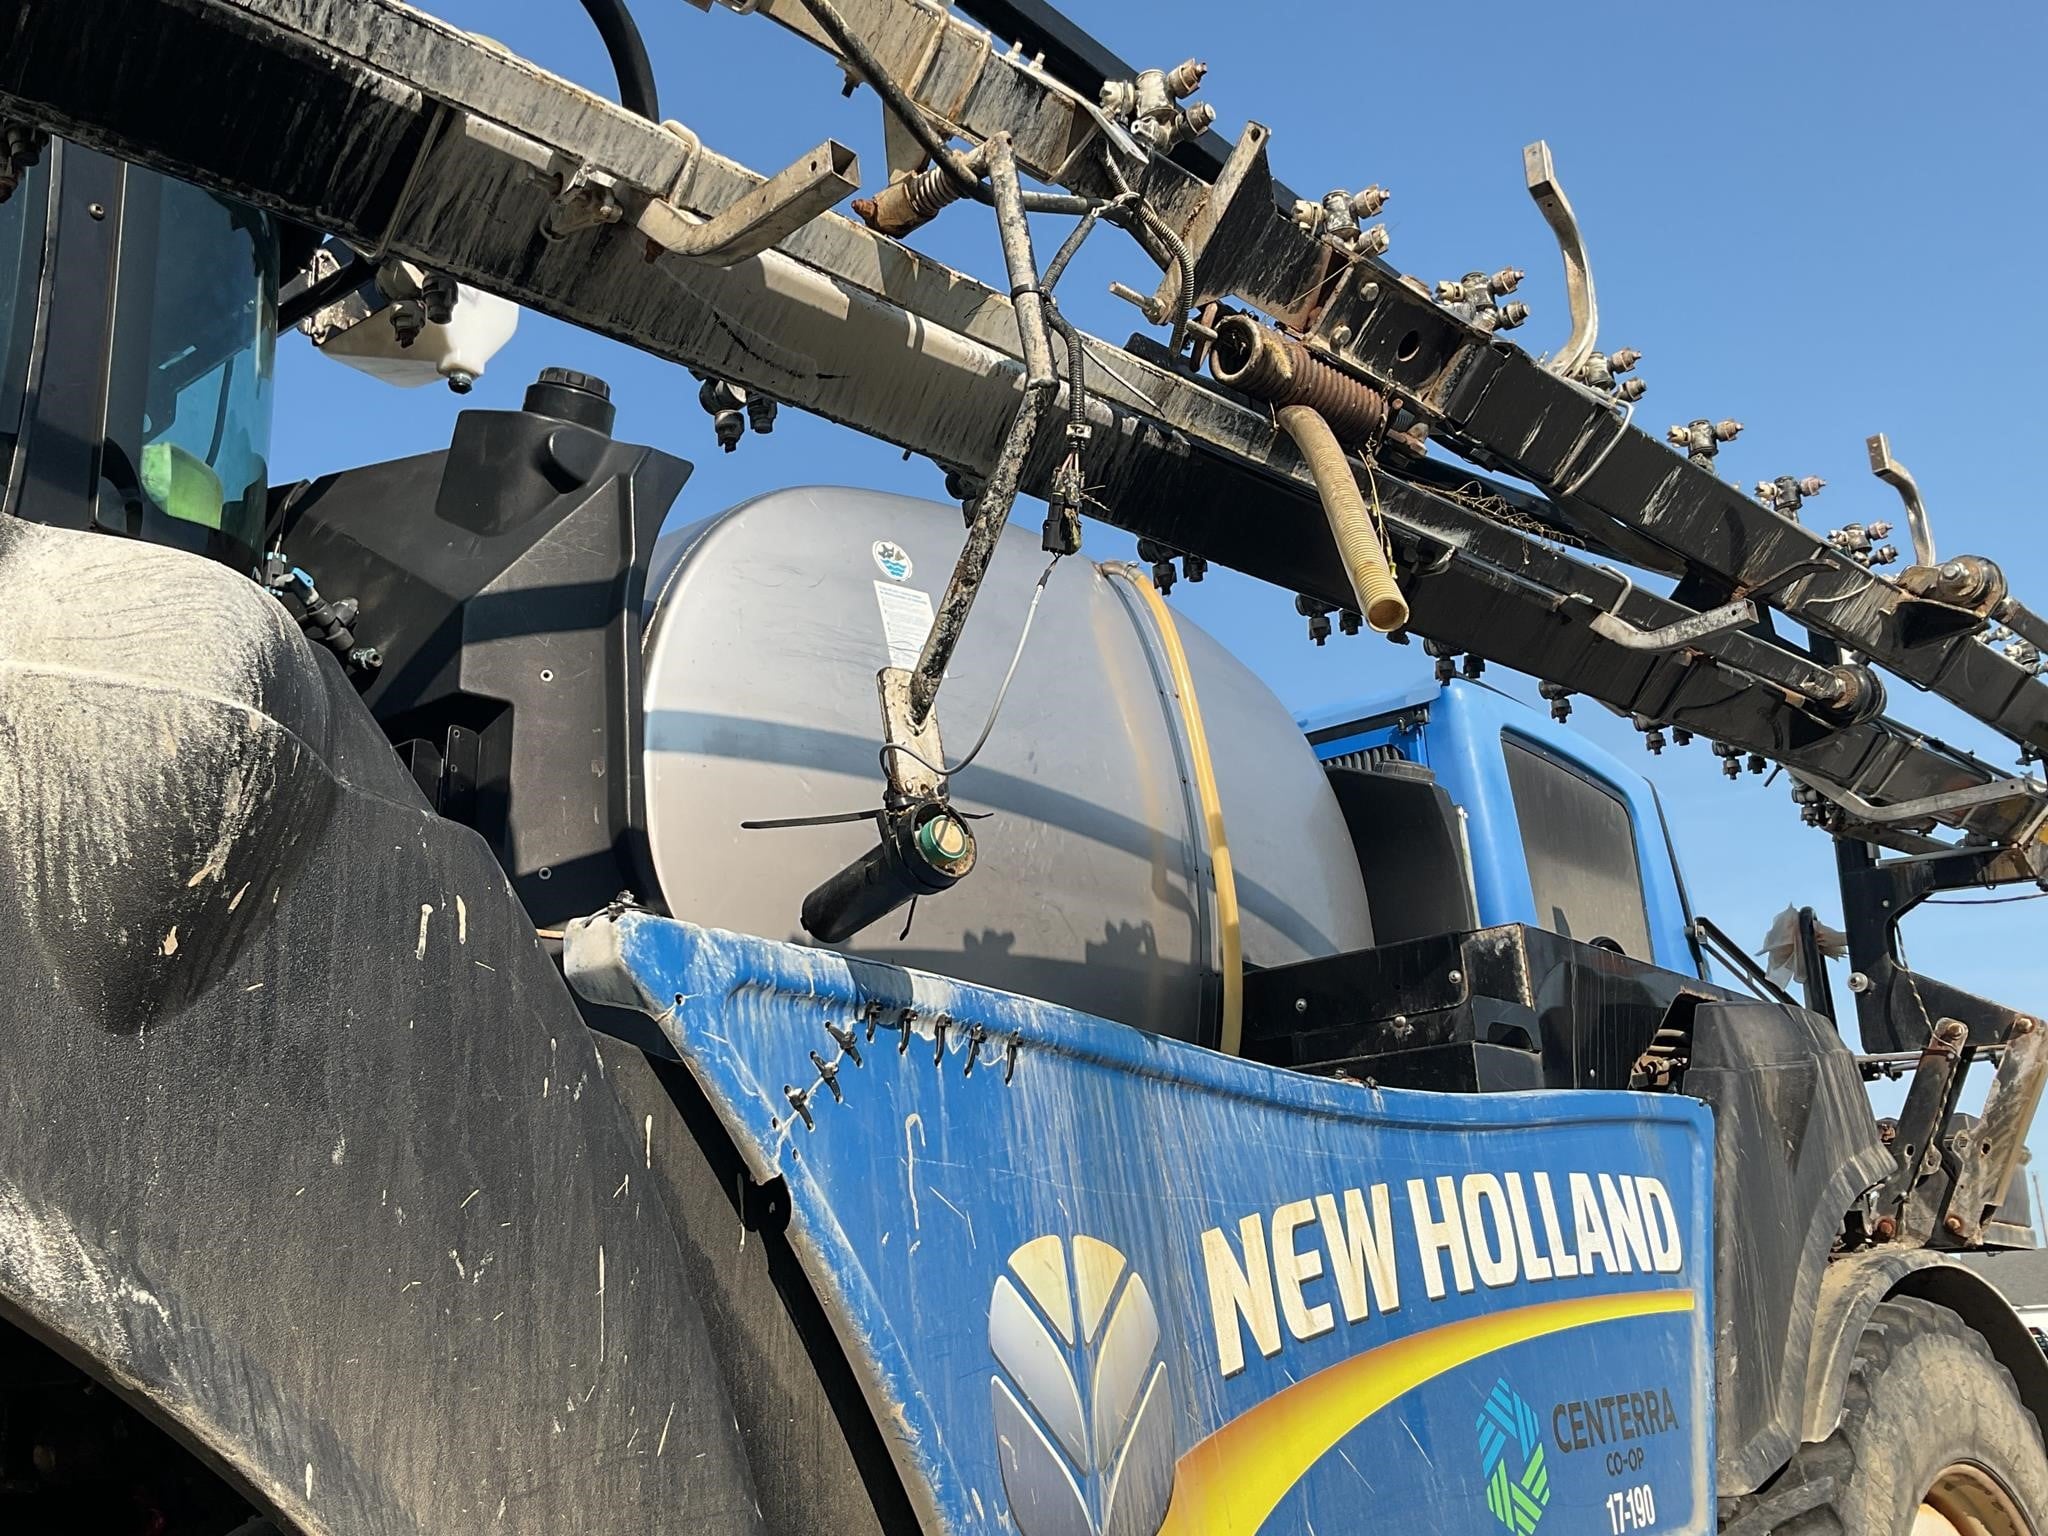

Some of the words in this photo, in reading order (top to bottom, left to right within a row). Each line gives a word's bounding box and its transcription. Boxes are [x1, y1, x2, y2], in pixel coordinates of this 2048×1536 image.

[1201, 1183, 1399, 1377] NEW
[1407, 1171, 1683, 1300] HOLLAND
[1552, 1387, 1679, 1454] CENTERRA
[1606, 1447, 1644, 1476] CO-OP
[1606, 1484, 1656, 1535] 17-190
